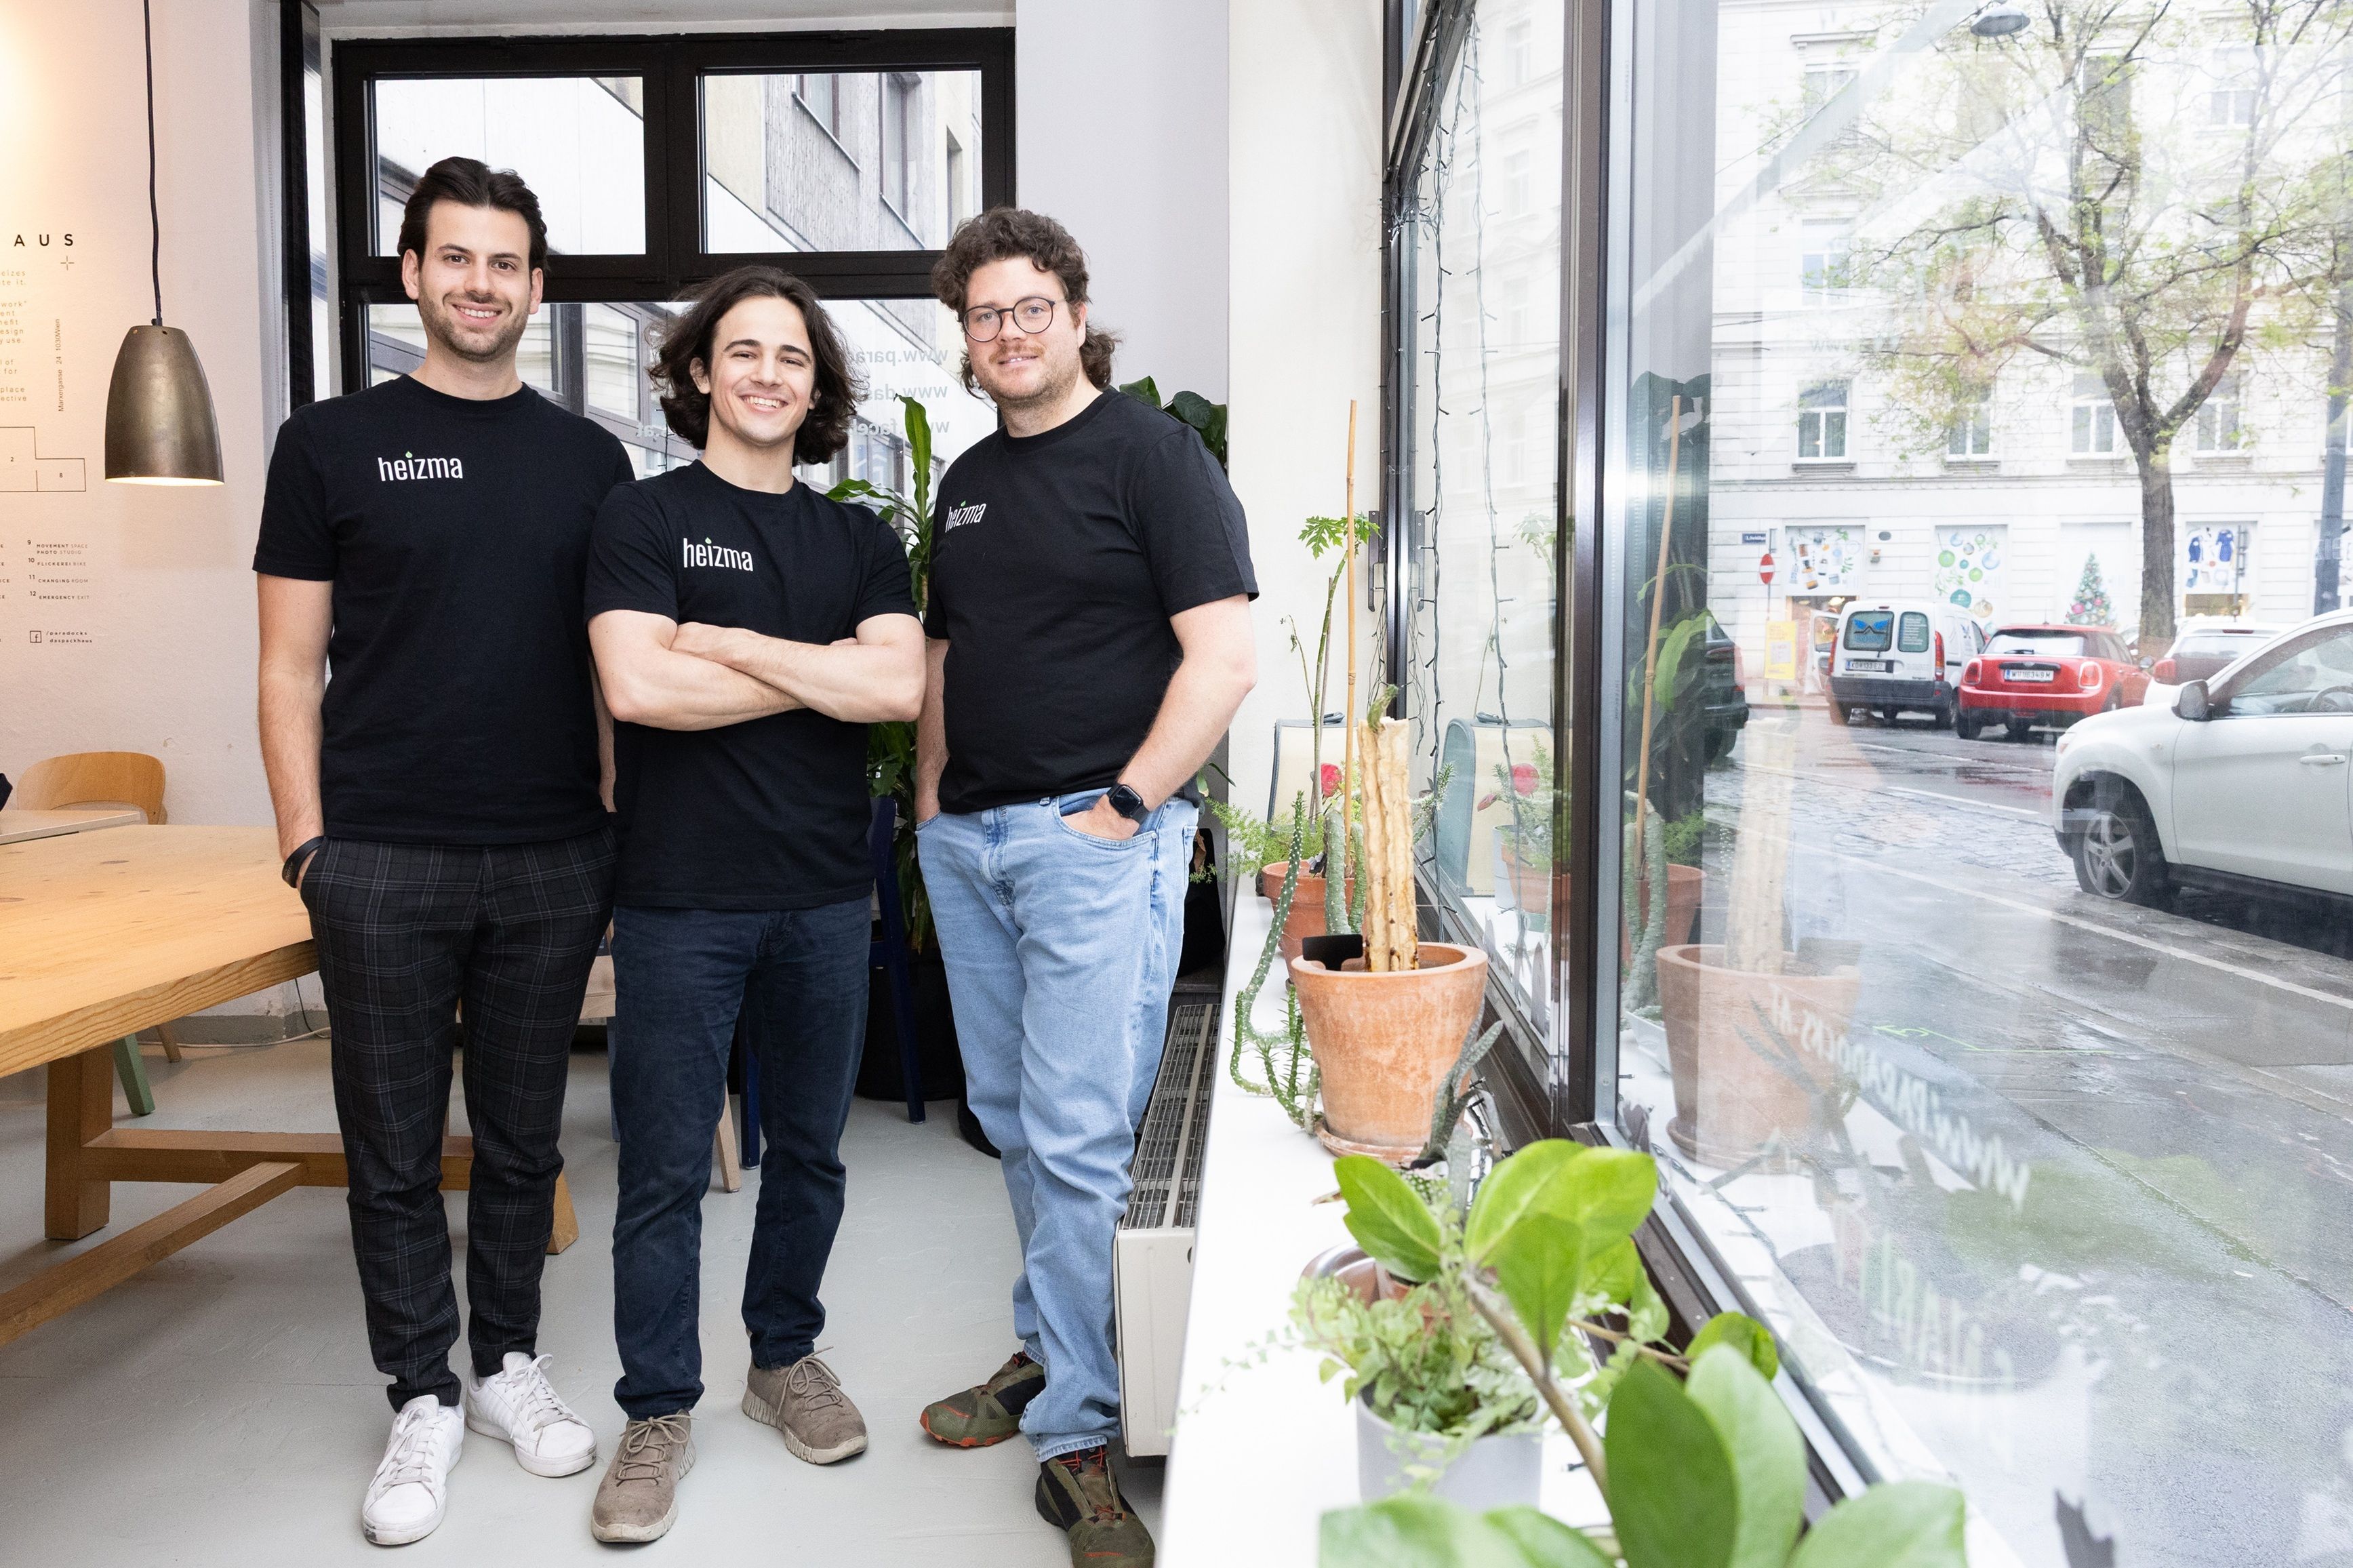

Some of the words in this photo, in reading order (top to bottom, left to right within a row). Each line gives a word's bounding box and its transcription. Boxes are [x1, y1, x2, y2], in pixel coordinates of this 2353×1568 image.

[56, 356, 62, 365] 24
[378, 451, 463, 481] heizma
[945, 500, 987, 533] heizma
[683, 537, 753, 571] heizma
